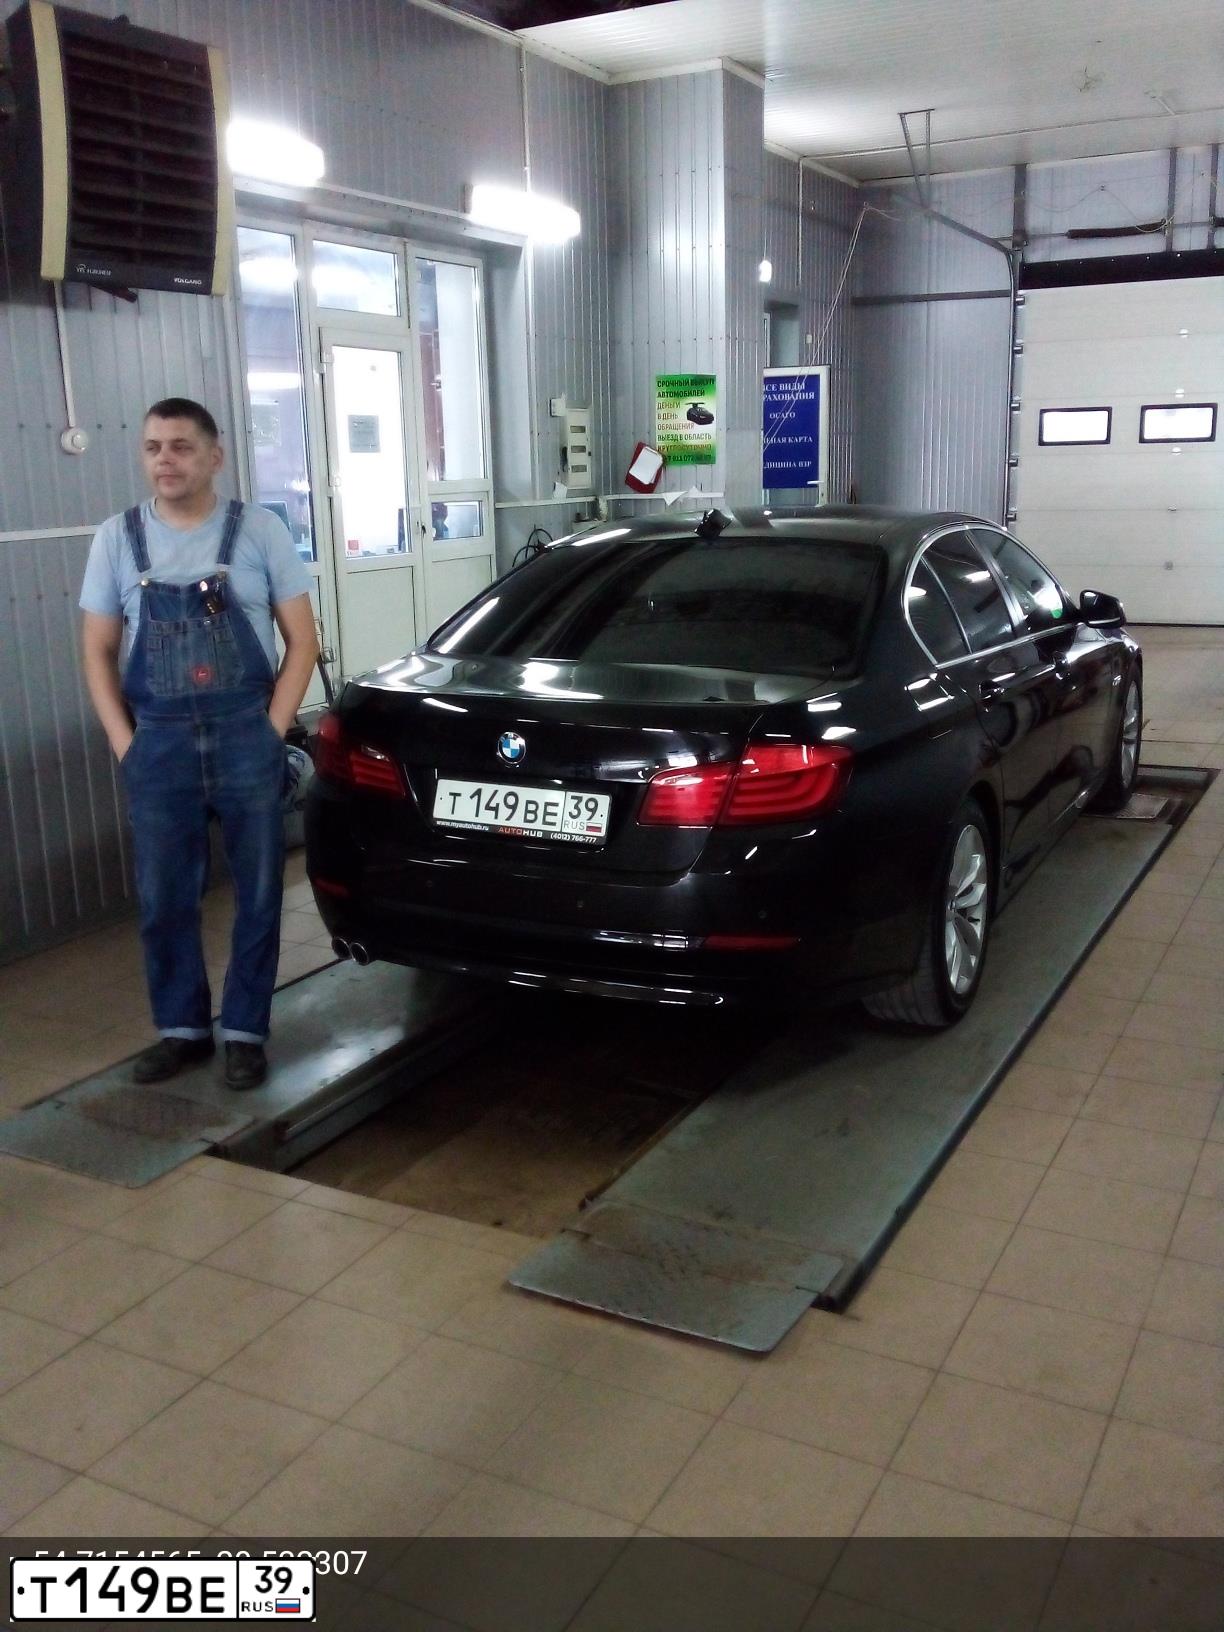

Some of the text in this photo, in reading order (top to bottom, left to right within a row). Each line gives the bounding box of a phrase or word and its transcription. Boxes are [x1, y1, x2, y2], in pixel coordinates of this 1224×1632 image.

[657, 379, 689, 388] СРОЧНЫЙ
[779, 382, 805, 391] ВИДЫ
[684, 432, 712, 441] ОБЛАСТЬ
[787, 435, 813, 443] КАРТА
[568, 795, 599, 821] 39
[436, 820, 489, 832] www.myautohub.ru
[564, 820, 585, 831] RUS
[498, 826, 543, 838] AUTOHUB
[550, 833, 570, 842] (4012)
